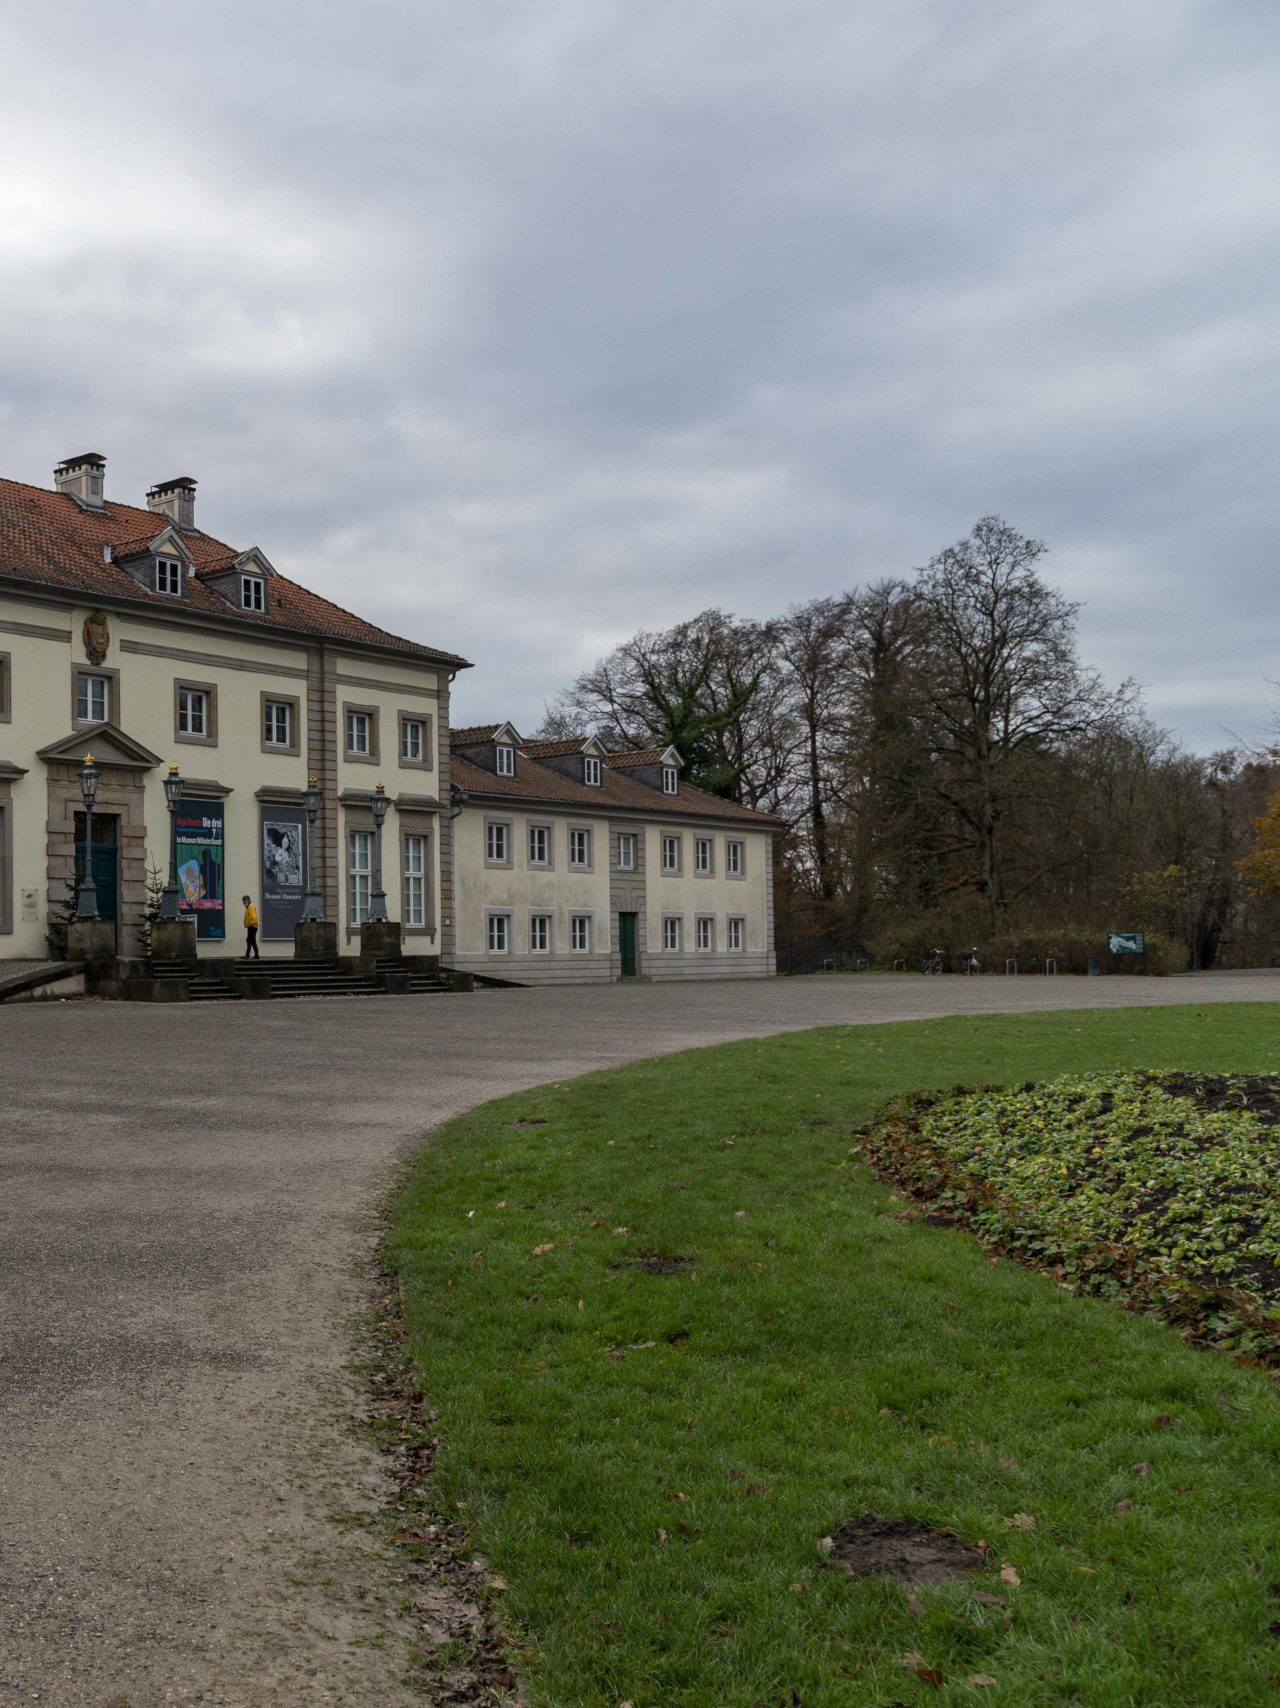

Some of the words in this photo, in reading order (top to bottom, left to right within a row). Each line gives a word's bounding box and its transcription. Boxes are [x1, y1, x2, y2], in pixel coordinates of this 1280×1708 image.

[202, 817, 211, 827] Die
[212, 817, 222, 828] drei
[182, 836, 196, 844] Museum
[197, 837, 211, 845] Wilhelm
